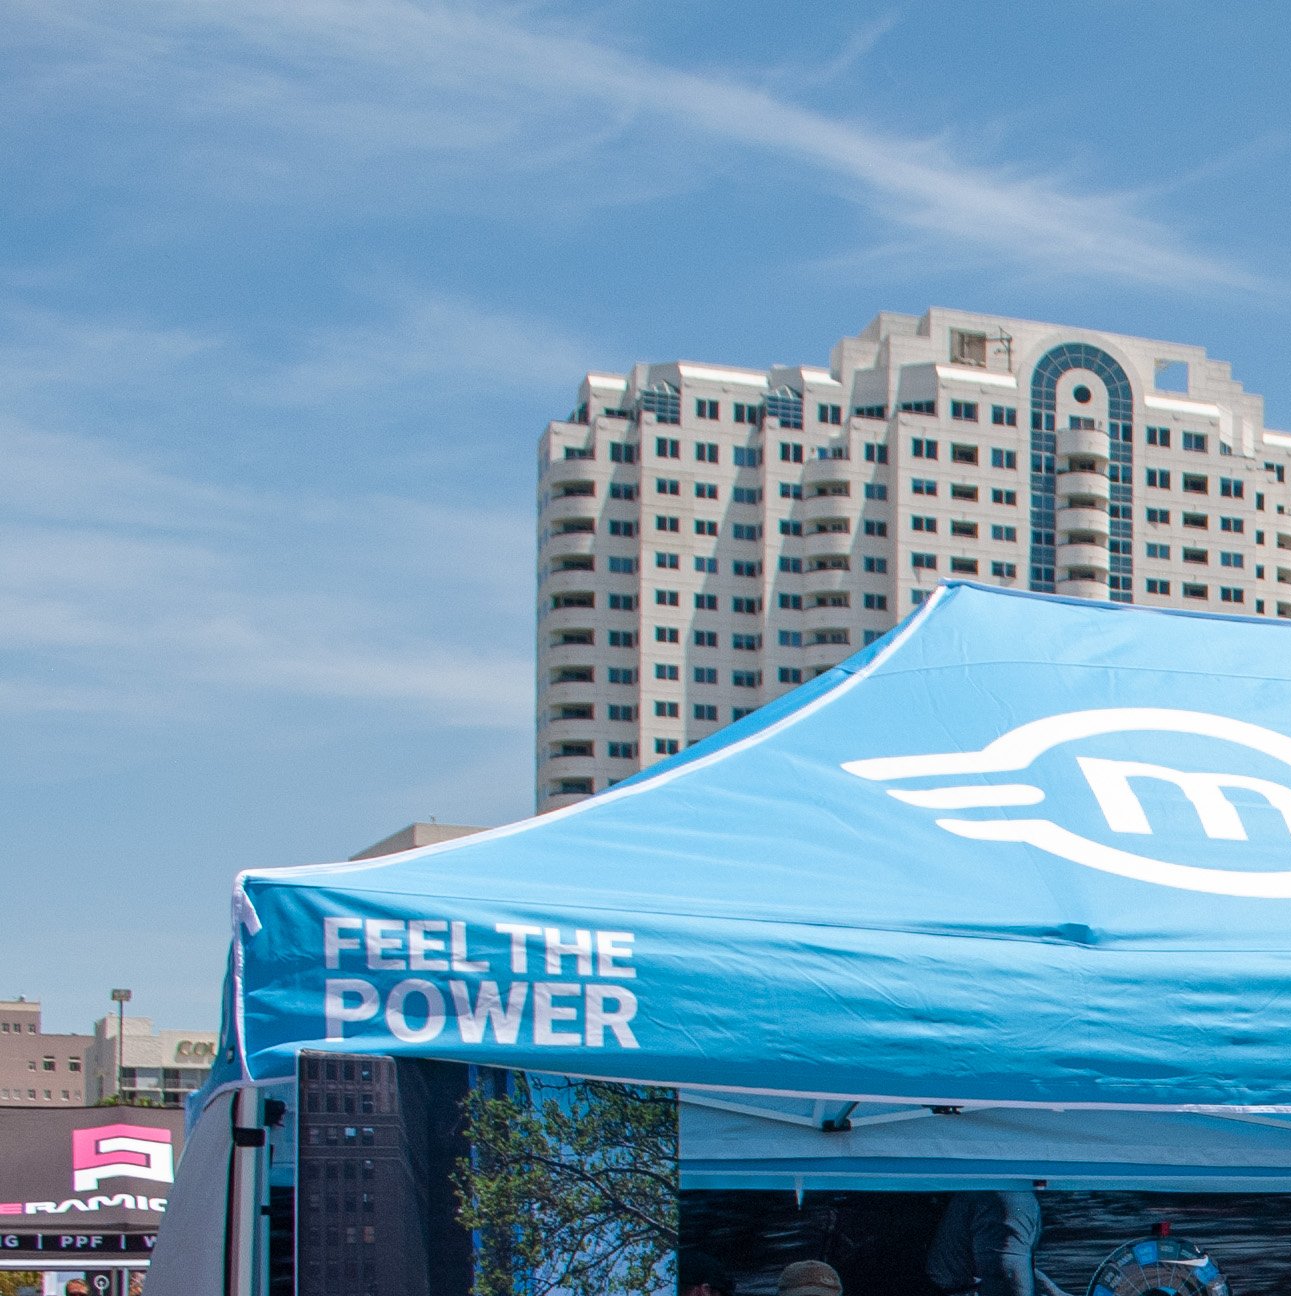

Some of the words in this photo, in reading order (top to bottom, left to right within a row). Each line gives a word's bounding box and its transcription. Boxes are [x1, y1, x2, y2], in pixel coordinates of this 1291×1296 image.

[323, 917, 490, 973] FEEL
[495, 922, 637, 978] THE
[323, 977, 641, 1049] POWER
[61, 1235, 104, 1248] PPF
